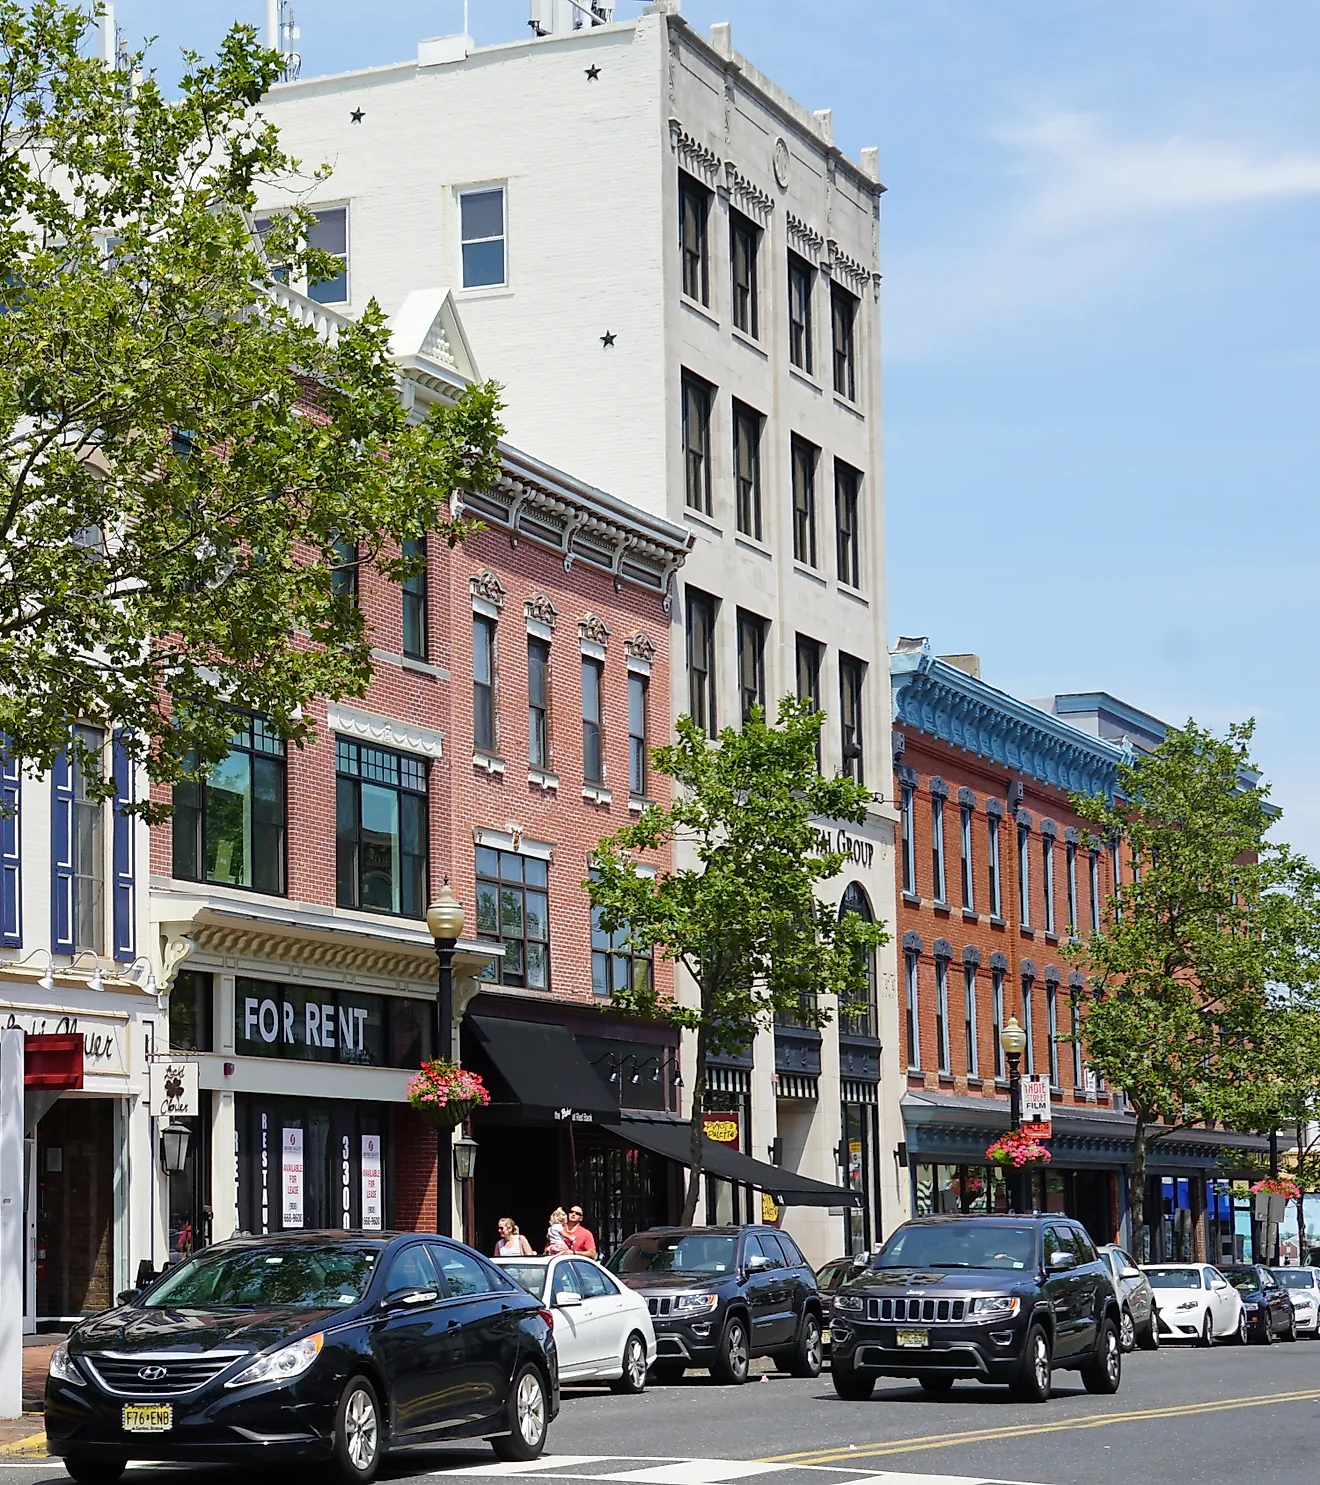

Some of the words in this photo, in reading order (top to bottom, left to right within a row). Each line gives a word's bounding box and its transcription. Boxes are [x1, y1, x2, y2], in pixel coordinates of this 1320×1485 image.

[836, 829, 875, 870] GROUP
[244, 997, 295, 1044] FOR
[305, 1002, 368, 1050] RENT
[1024, 1083, 1047, 1094] INDIE
[1025, 1094, 1047, 1103] STREET
[906, 1289, 926, 1297] Jeep
